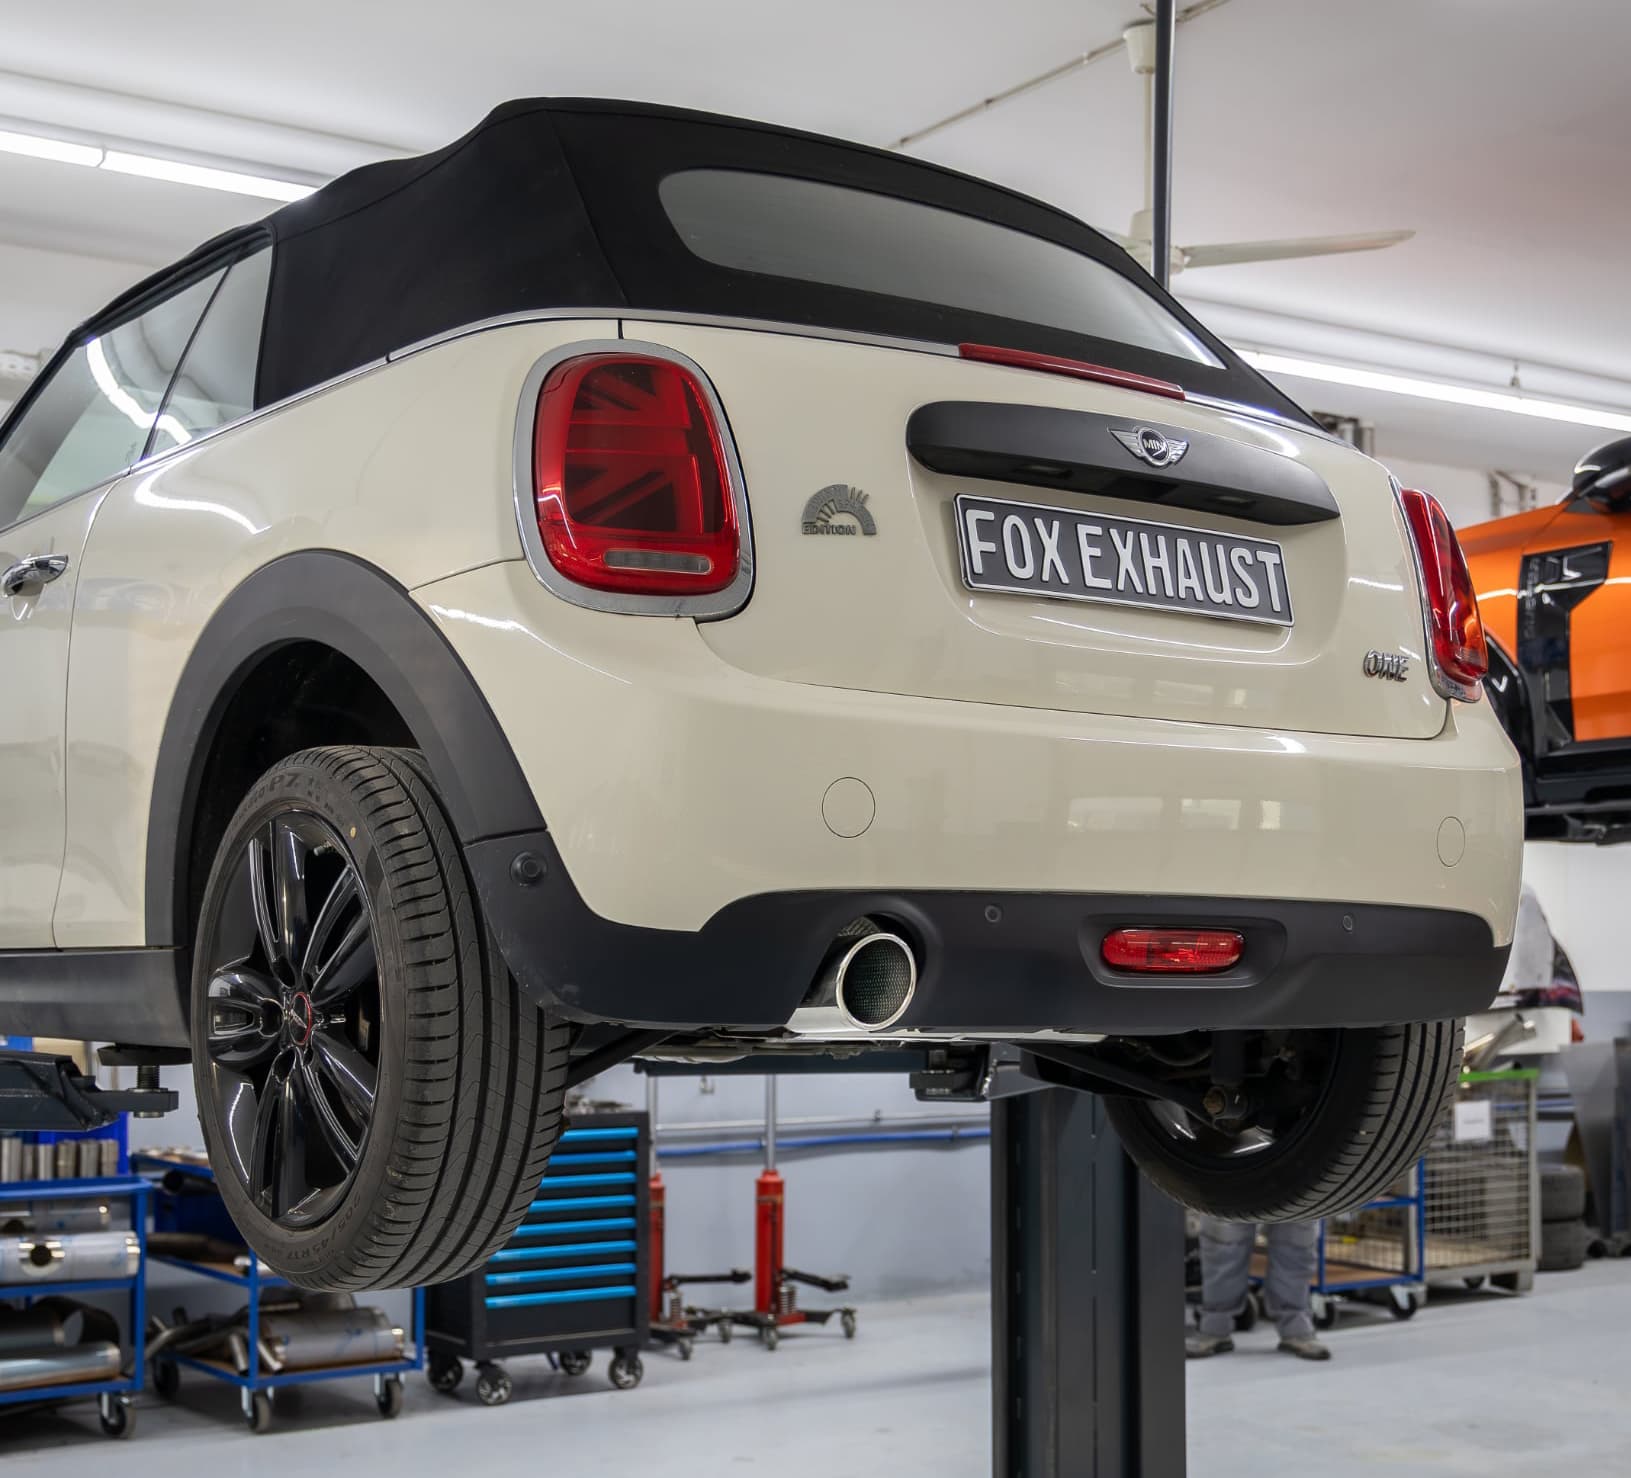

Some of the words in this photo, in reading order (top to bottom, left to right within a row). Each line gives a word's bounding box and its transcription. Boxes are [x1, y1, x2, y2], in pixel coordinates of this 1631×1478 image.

[802, 524, 857, 536] EDITION
[965, 509, 1070, 585] FOX
[1076, 523, 1281, 612] EXHAUST
[1363, 650, 1409, 682] ONE
